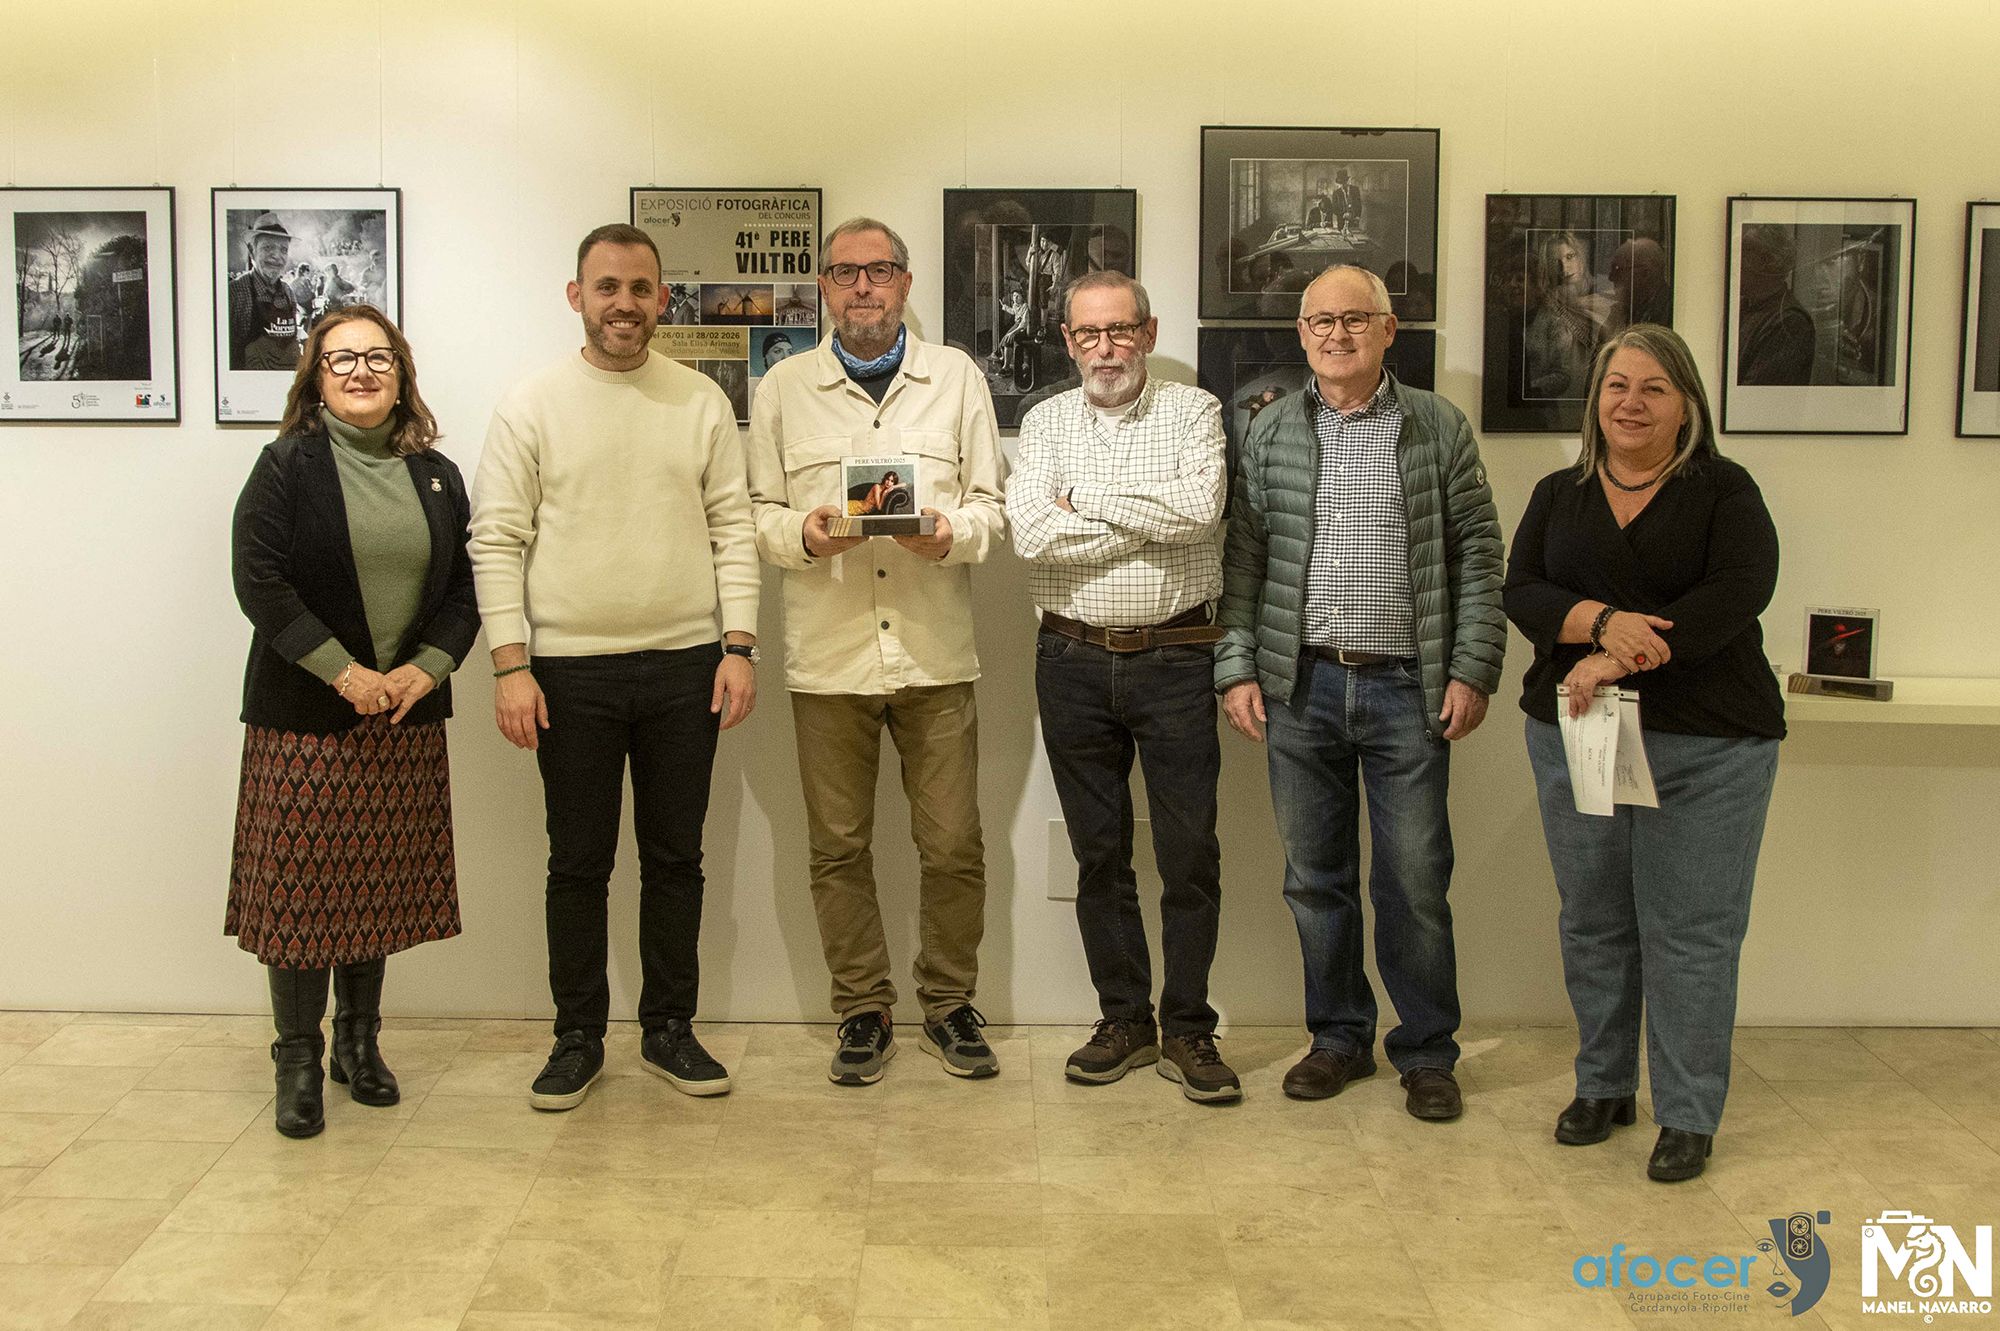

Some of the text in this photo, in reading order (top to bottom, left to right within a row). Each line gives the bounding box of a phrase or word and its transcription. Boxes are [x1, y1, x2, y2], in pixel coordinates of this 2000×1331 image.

[641, 197, 811, 211] EXPOSICIÓ FOTOGRÀFICA
[758, 212, 811, 220] DEL CONCURS
[770, 230, 811, 248] PERE
[735, 248, 811, 274] VILTRÓ
[661, 331, 685, 340] 26/01
[696, 331, 719, 339] 28/02
[720, 331, 740, 339] 2026
[710, 340, 740, 349] Arimany
